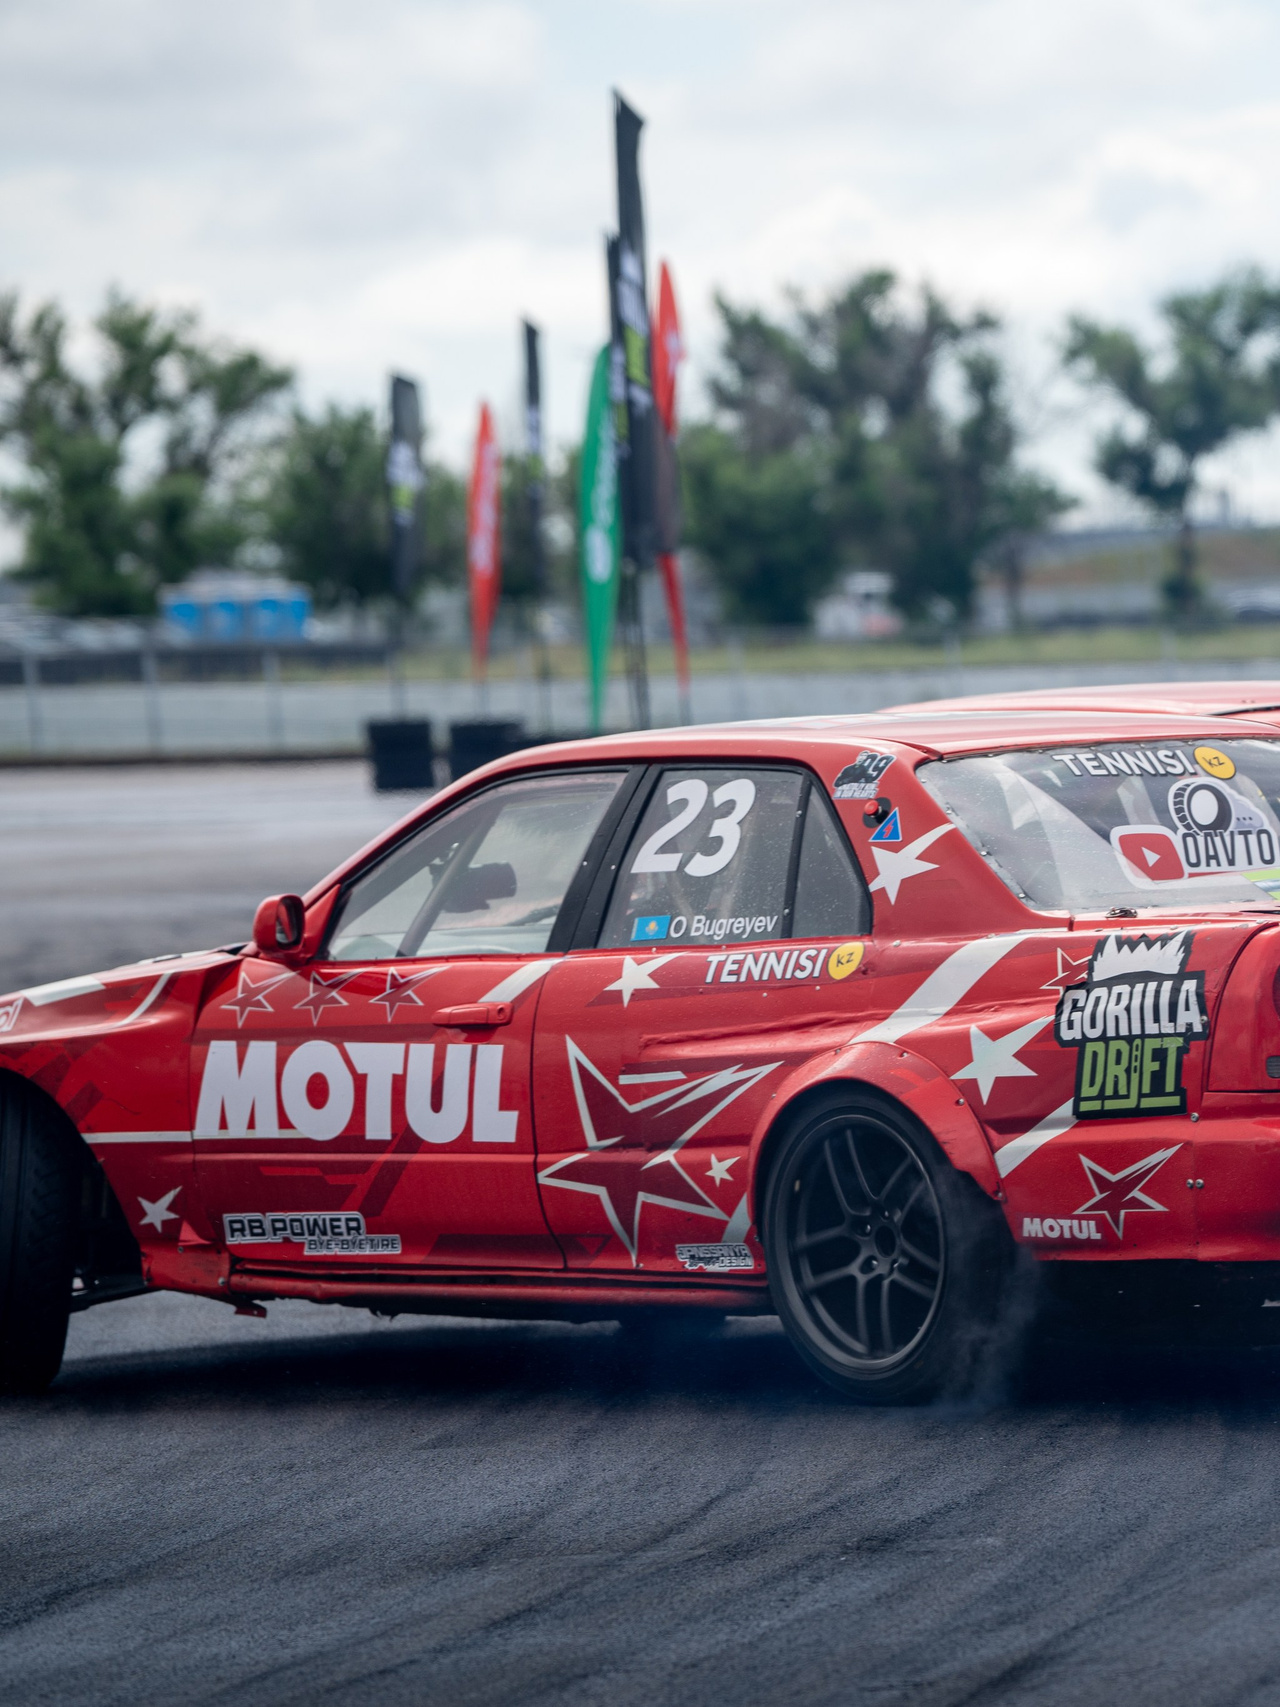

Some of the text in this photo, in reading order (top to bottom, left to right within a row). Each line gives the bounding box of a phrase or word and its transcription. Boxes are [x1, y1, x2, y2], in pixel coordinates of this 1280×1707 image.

[1053, 749, 1225, 777] TENNISI kz
[630, 778, 757, 877] 23
[1182, 828, 1277, 867] OAVTO
[669, 914, 778, 941] O Bugreyev
[704, 948, 855, 984] TENNISI kz
[1059, 979, 1203, 1041] GORILLA
[1079, 1036, 1185, 1110] DRIFT
[194, 1039, 519, 1144] MOTUL
[228, 1216, 364, 1239] RB POWER
[1022, 1217, 1102, 1240] MOTUL
[719, 1256, 754, 1267] DESIGN
